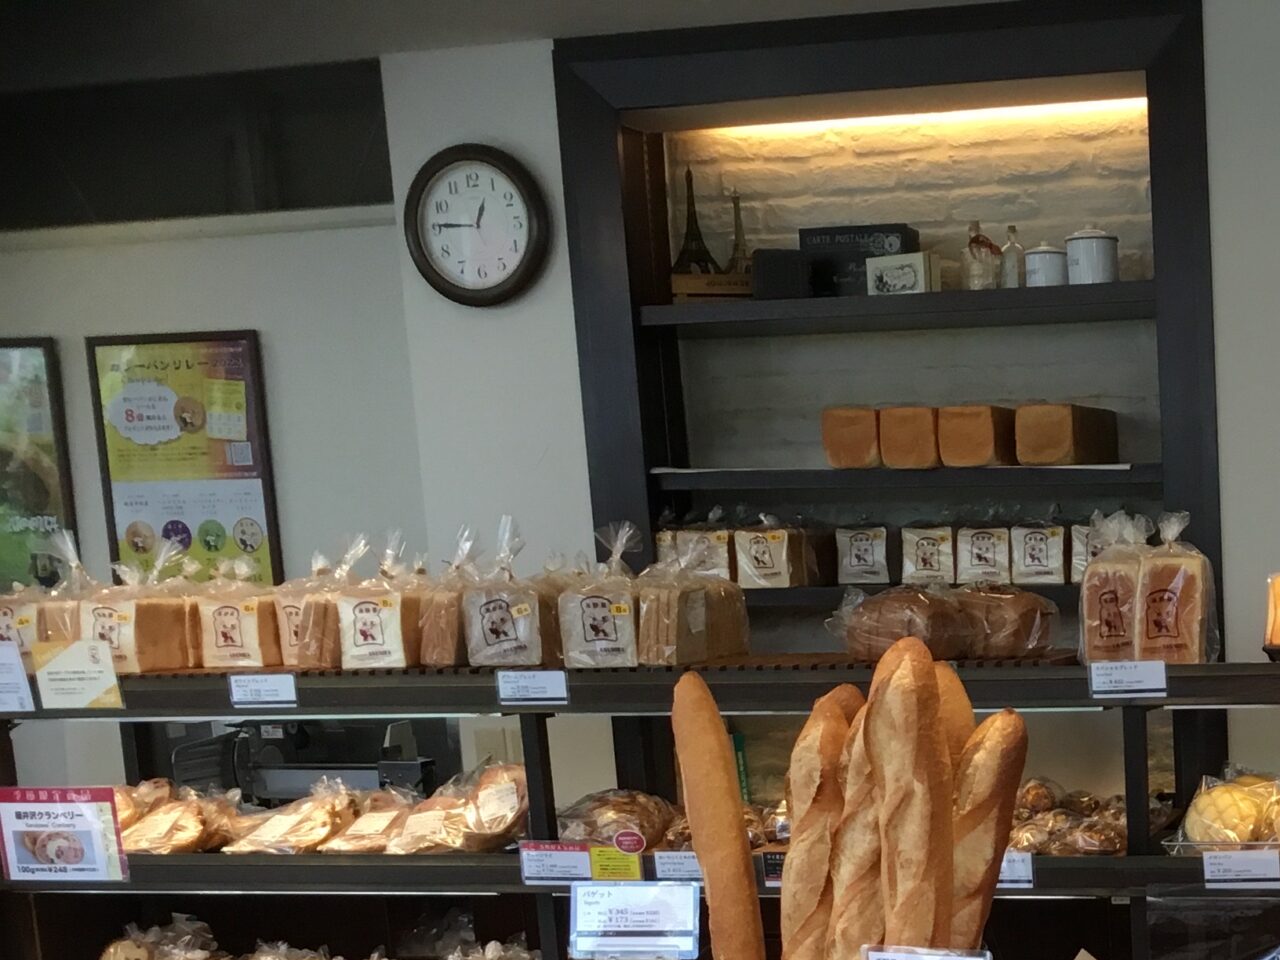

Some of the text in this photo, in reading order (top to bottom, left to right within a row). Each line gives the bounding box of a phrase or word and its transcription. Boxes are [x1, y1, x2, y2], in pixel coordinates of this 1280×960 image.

[466, 172, 480, 188] 12
[490, 178, 495, 191] 1
[448, 181, 458, 195] 11
[503, 192, 514, 207] 2
[435, 200, 448, 214] 10
[441, 244, 451, 258] 8
[457, 260, 466, 274] 7
[498, 258, 506, 271] 5
[477, 265, 487, 279] 6
